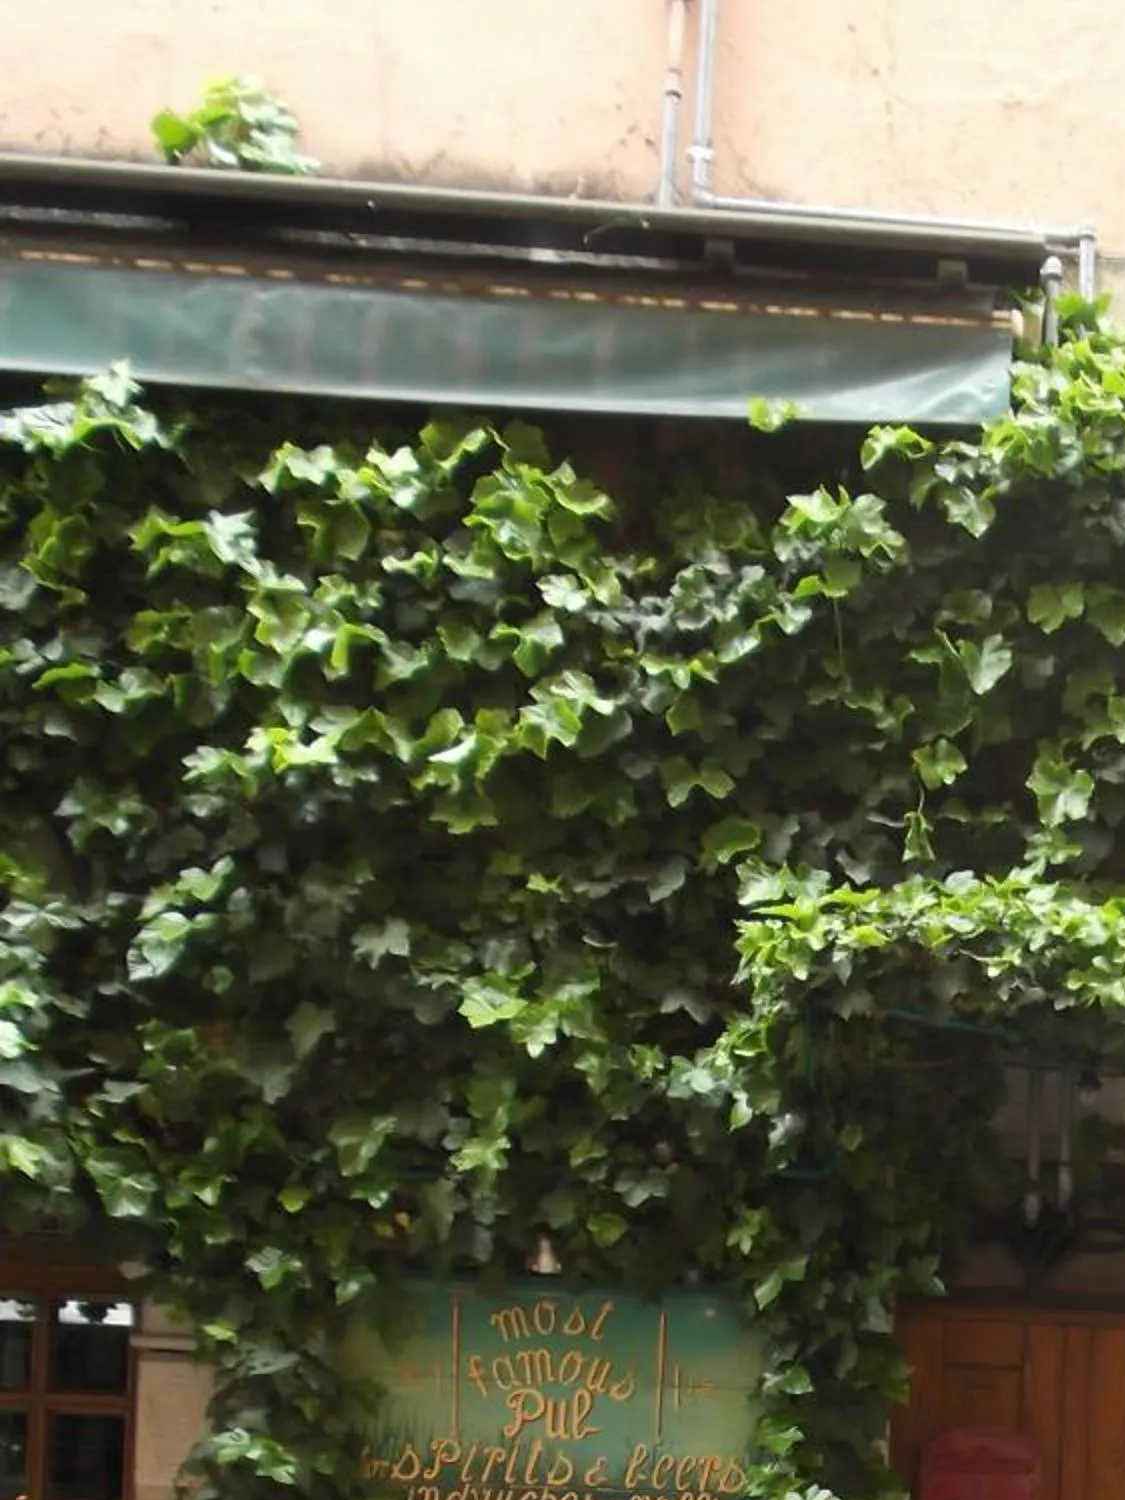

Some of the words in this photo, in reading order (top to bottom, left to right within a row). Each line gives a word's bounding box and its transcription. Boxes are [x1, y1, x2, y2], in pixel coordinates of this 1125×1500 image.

[490, 1299, 615, 1343] most
[469, 1348, 635, 1400] famous
[504, 1387, 601, 1440] Pub
[625, 1443, 747, 1492] beers
